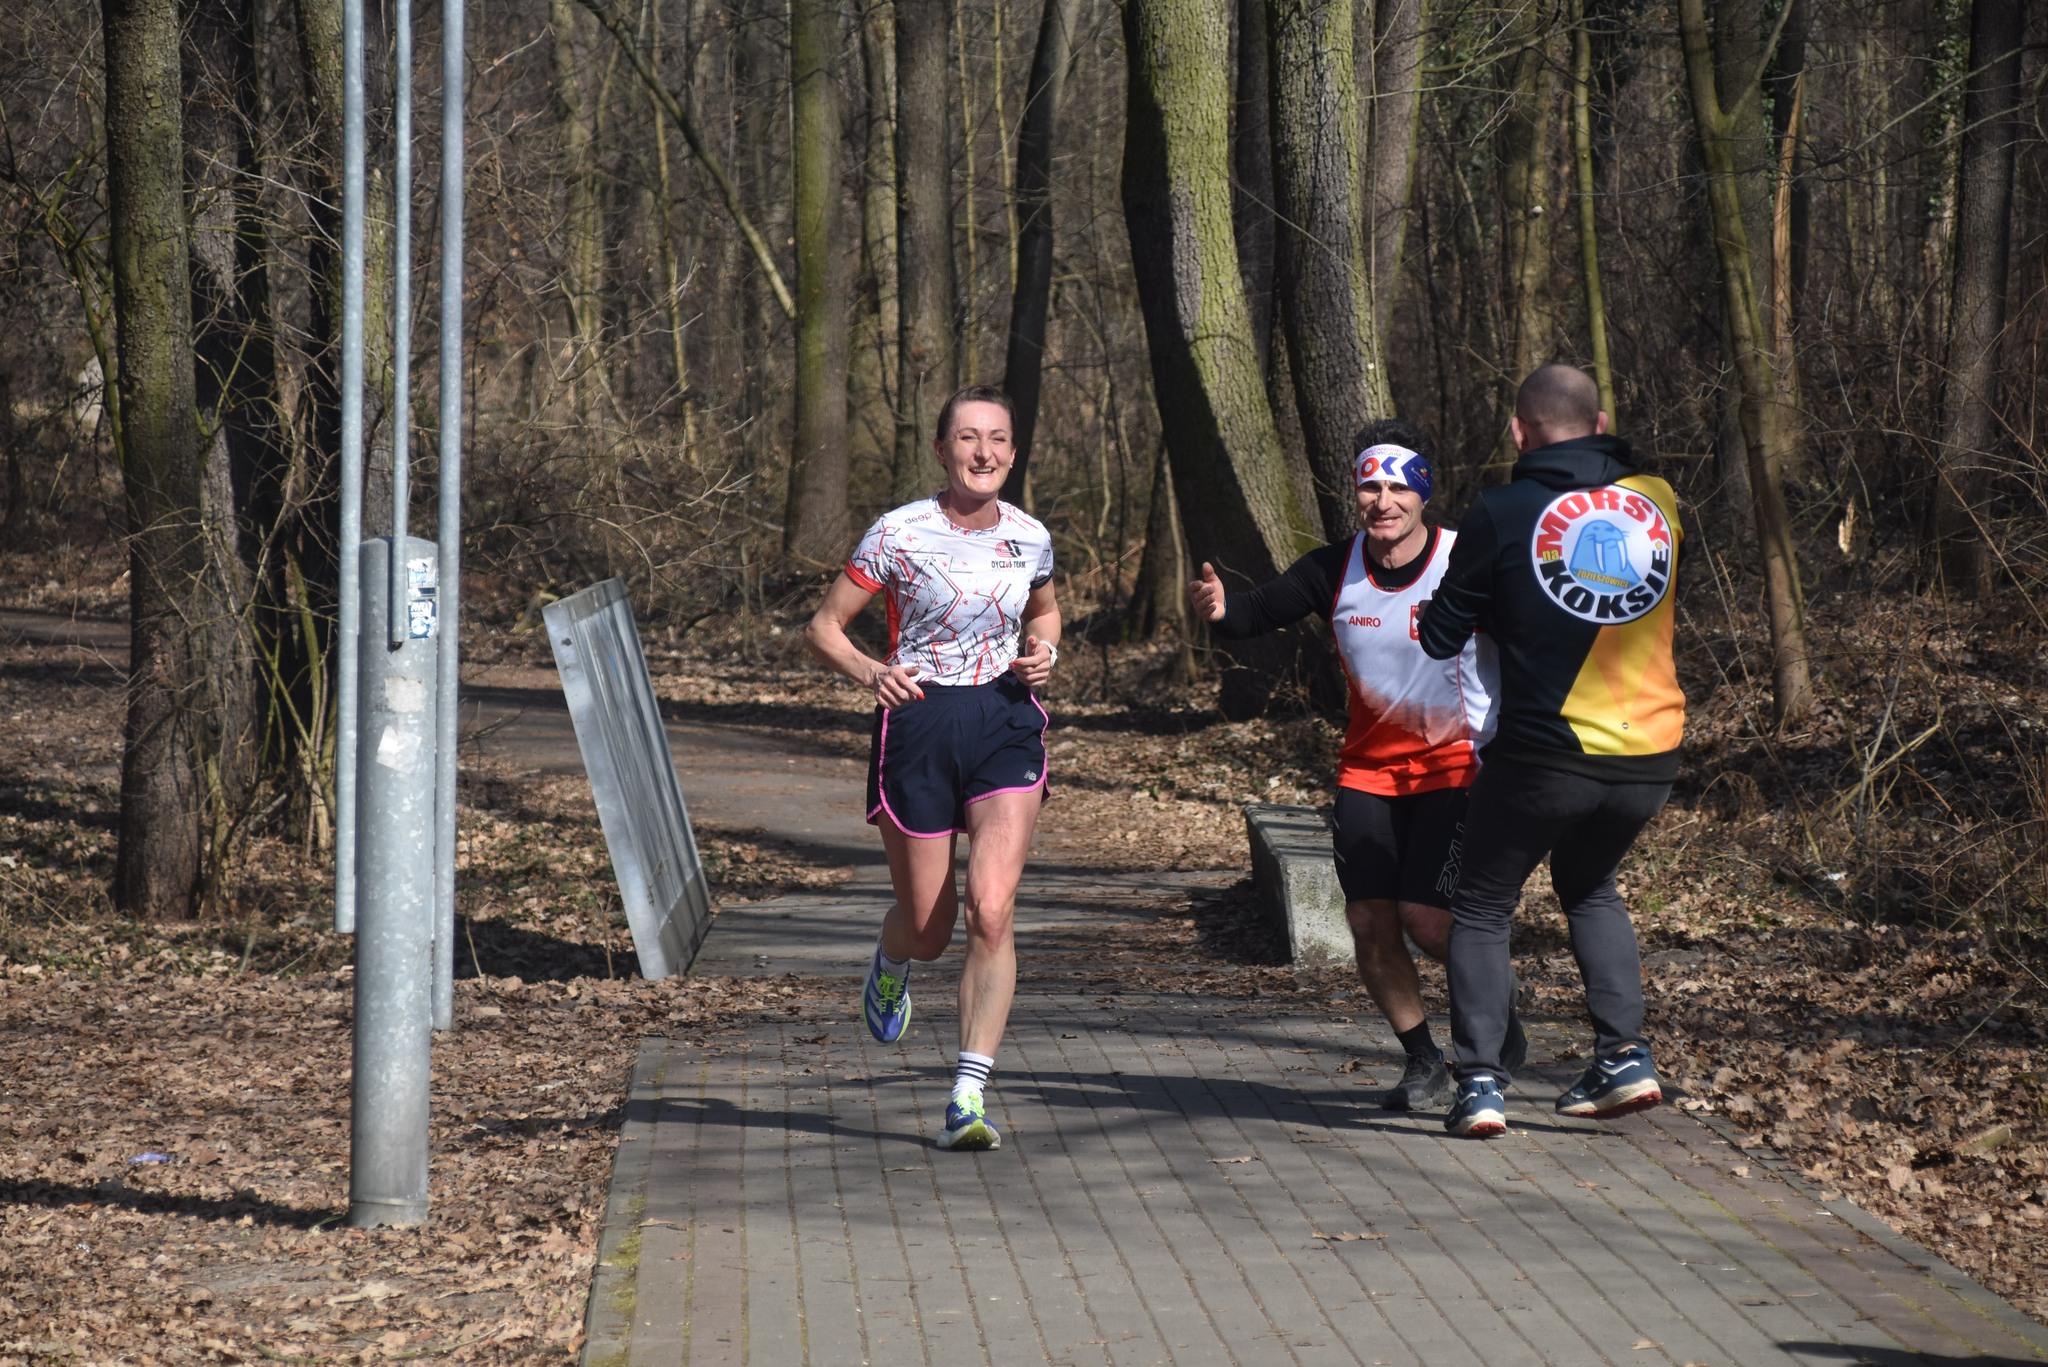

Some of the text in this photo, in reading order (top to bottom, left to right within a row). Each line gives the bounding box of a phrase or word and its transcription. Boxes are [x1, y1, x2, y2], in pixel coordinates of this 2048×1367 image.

[1537, 489, 1670, 558] MORSY
[1543, 549, 1560, 562] na
[1539, 549, 1669, 619] KOKSIE
[1348, 615, 1381, 628] ANIRO
